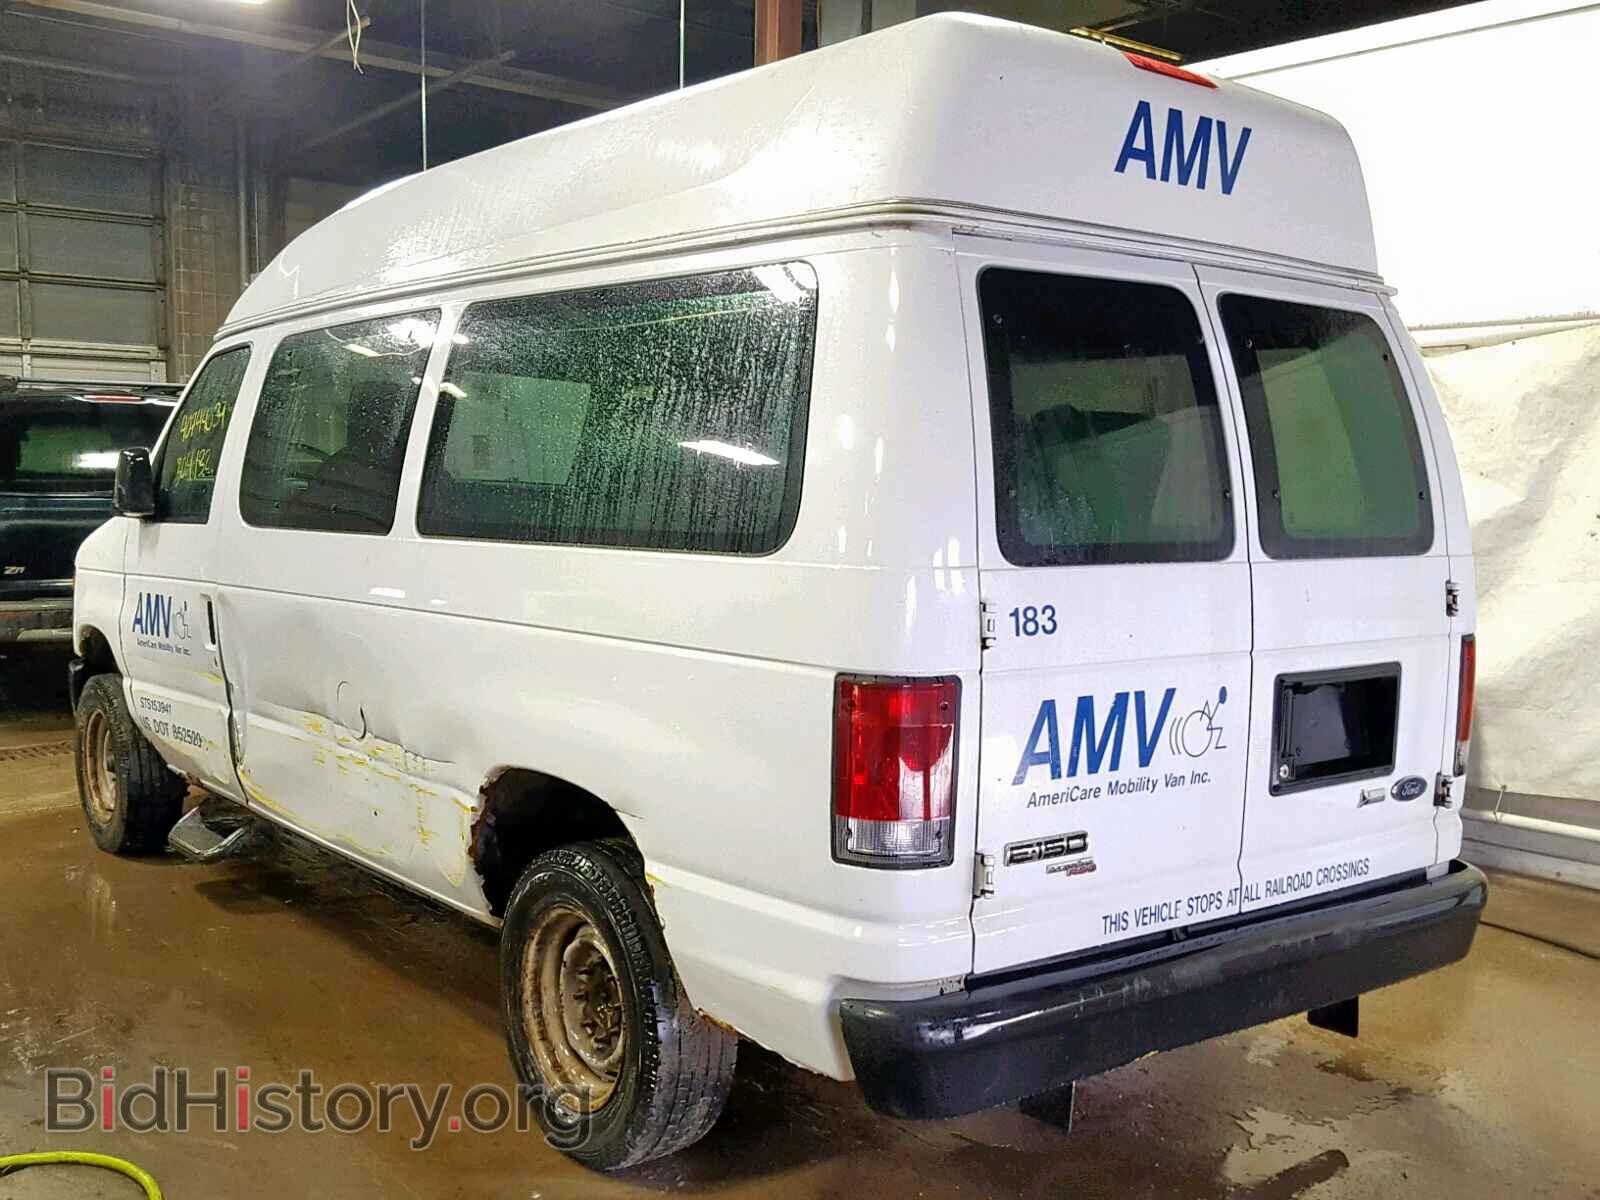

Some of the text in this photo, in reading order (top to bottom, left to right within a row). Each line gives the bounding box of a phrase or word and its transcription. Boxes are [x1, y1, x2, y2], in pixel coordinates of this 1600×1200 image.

[1114, 100, 1252, 195] AMV
[132, 592, 172, 638] AMV
[1009, 605, 1058, 637] 183
[153, 718, 169, 737] DOT
[1011, 687, 1176, 786] AMV
[1027, 770, 1211, 808] AmeriCare Mobility Van Inc.
[1102, 857, 1370, 935] THIS VEHICLE STOPS AT ALL RAILROAD CROSSINGS
